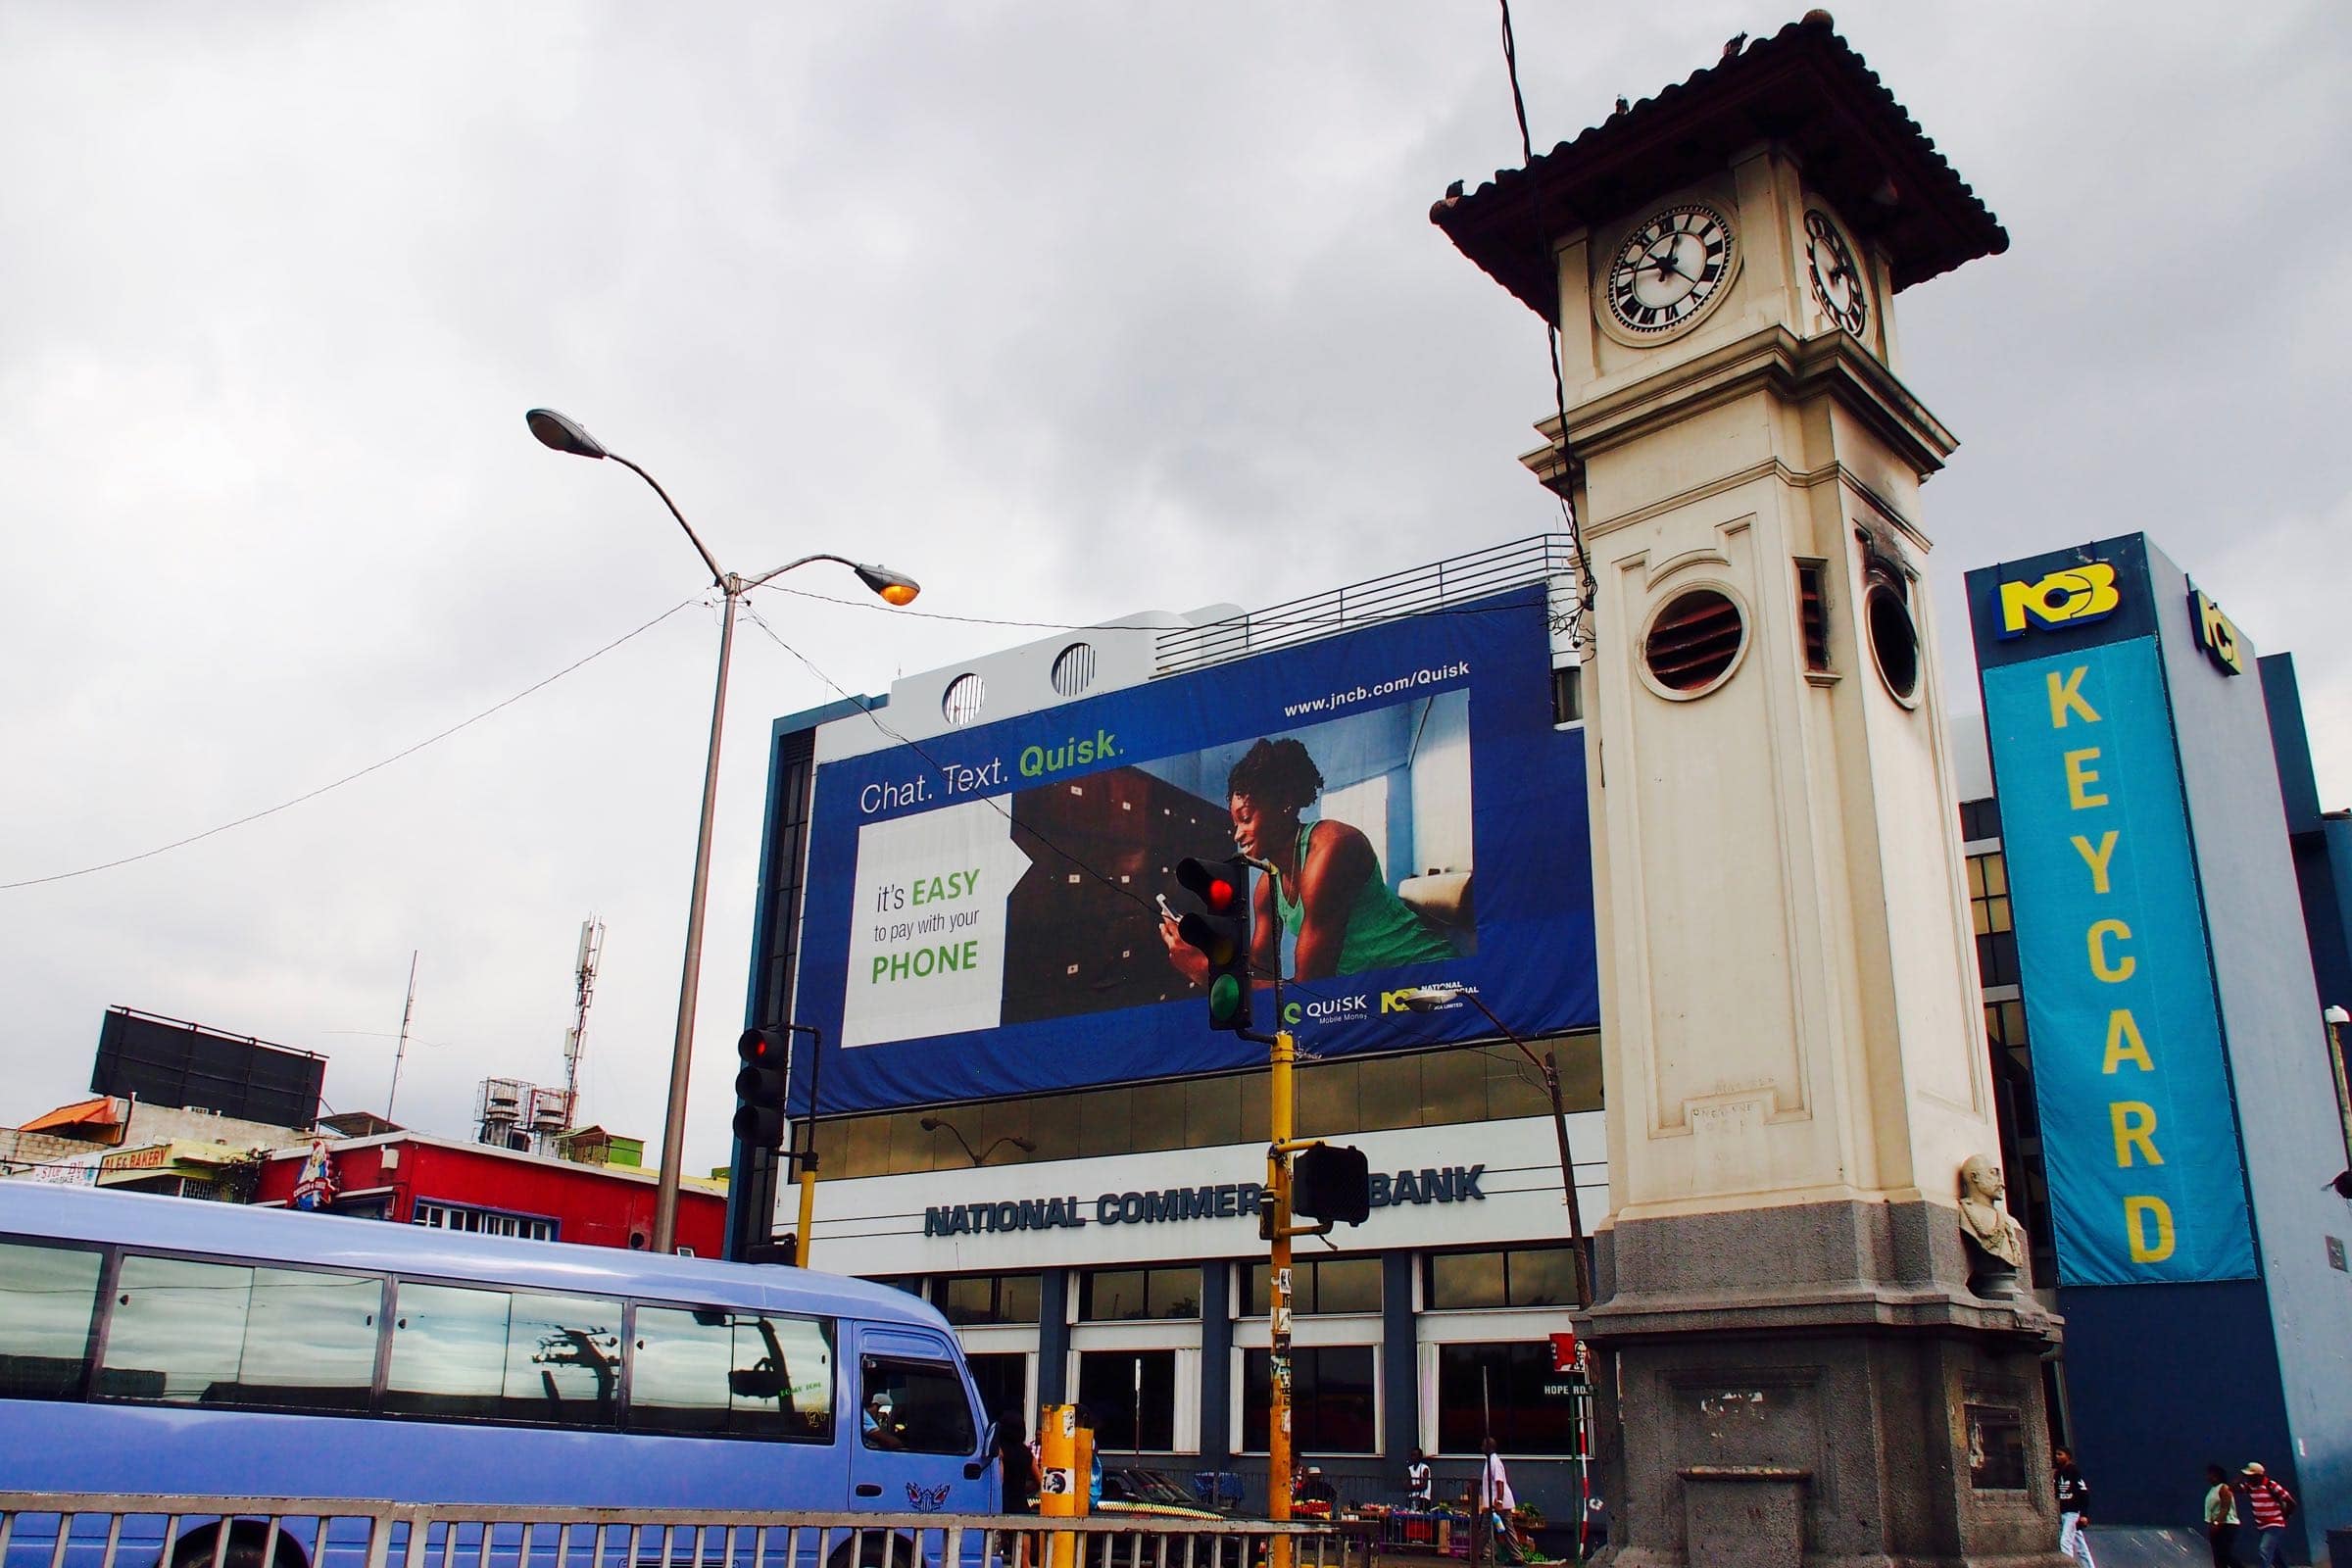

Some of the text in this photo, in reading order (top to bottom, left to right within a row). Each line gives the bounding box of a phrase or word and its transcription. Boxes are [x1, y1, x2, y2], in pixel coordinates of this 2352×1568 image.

[1999, 561, 2121, 633] NCB
[1284, 660, 1470, 717] www.jncb.com/Quisk
[860, 729, 1124, 814] Chat. Text. Quisk.
[877, 868, 981, 913] it's EASY
[874, 909, 980, 944] to pay with your
[871, 940, 978, 985] PHONE
[2047, 664, 2177, 1265] KEYCARD
[1319, 1012, 1367, 1025] Mobile Money
[129, 1149, 167, 1168] BAKERY
[924, 1163, 1487, 1237] NATIONAL COMMER BANK
[1544, 1385, 1569, 1395] HOPE
